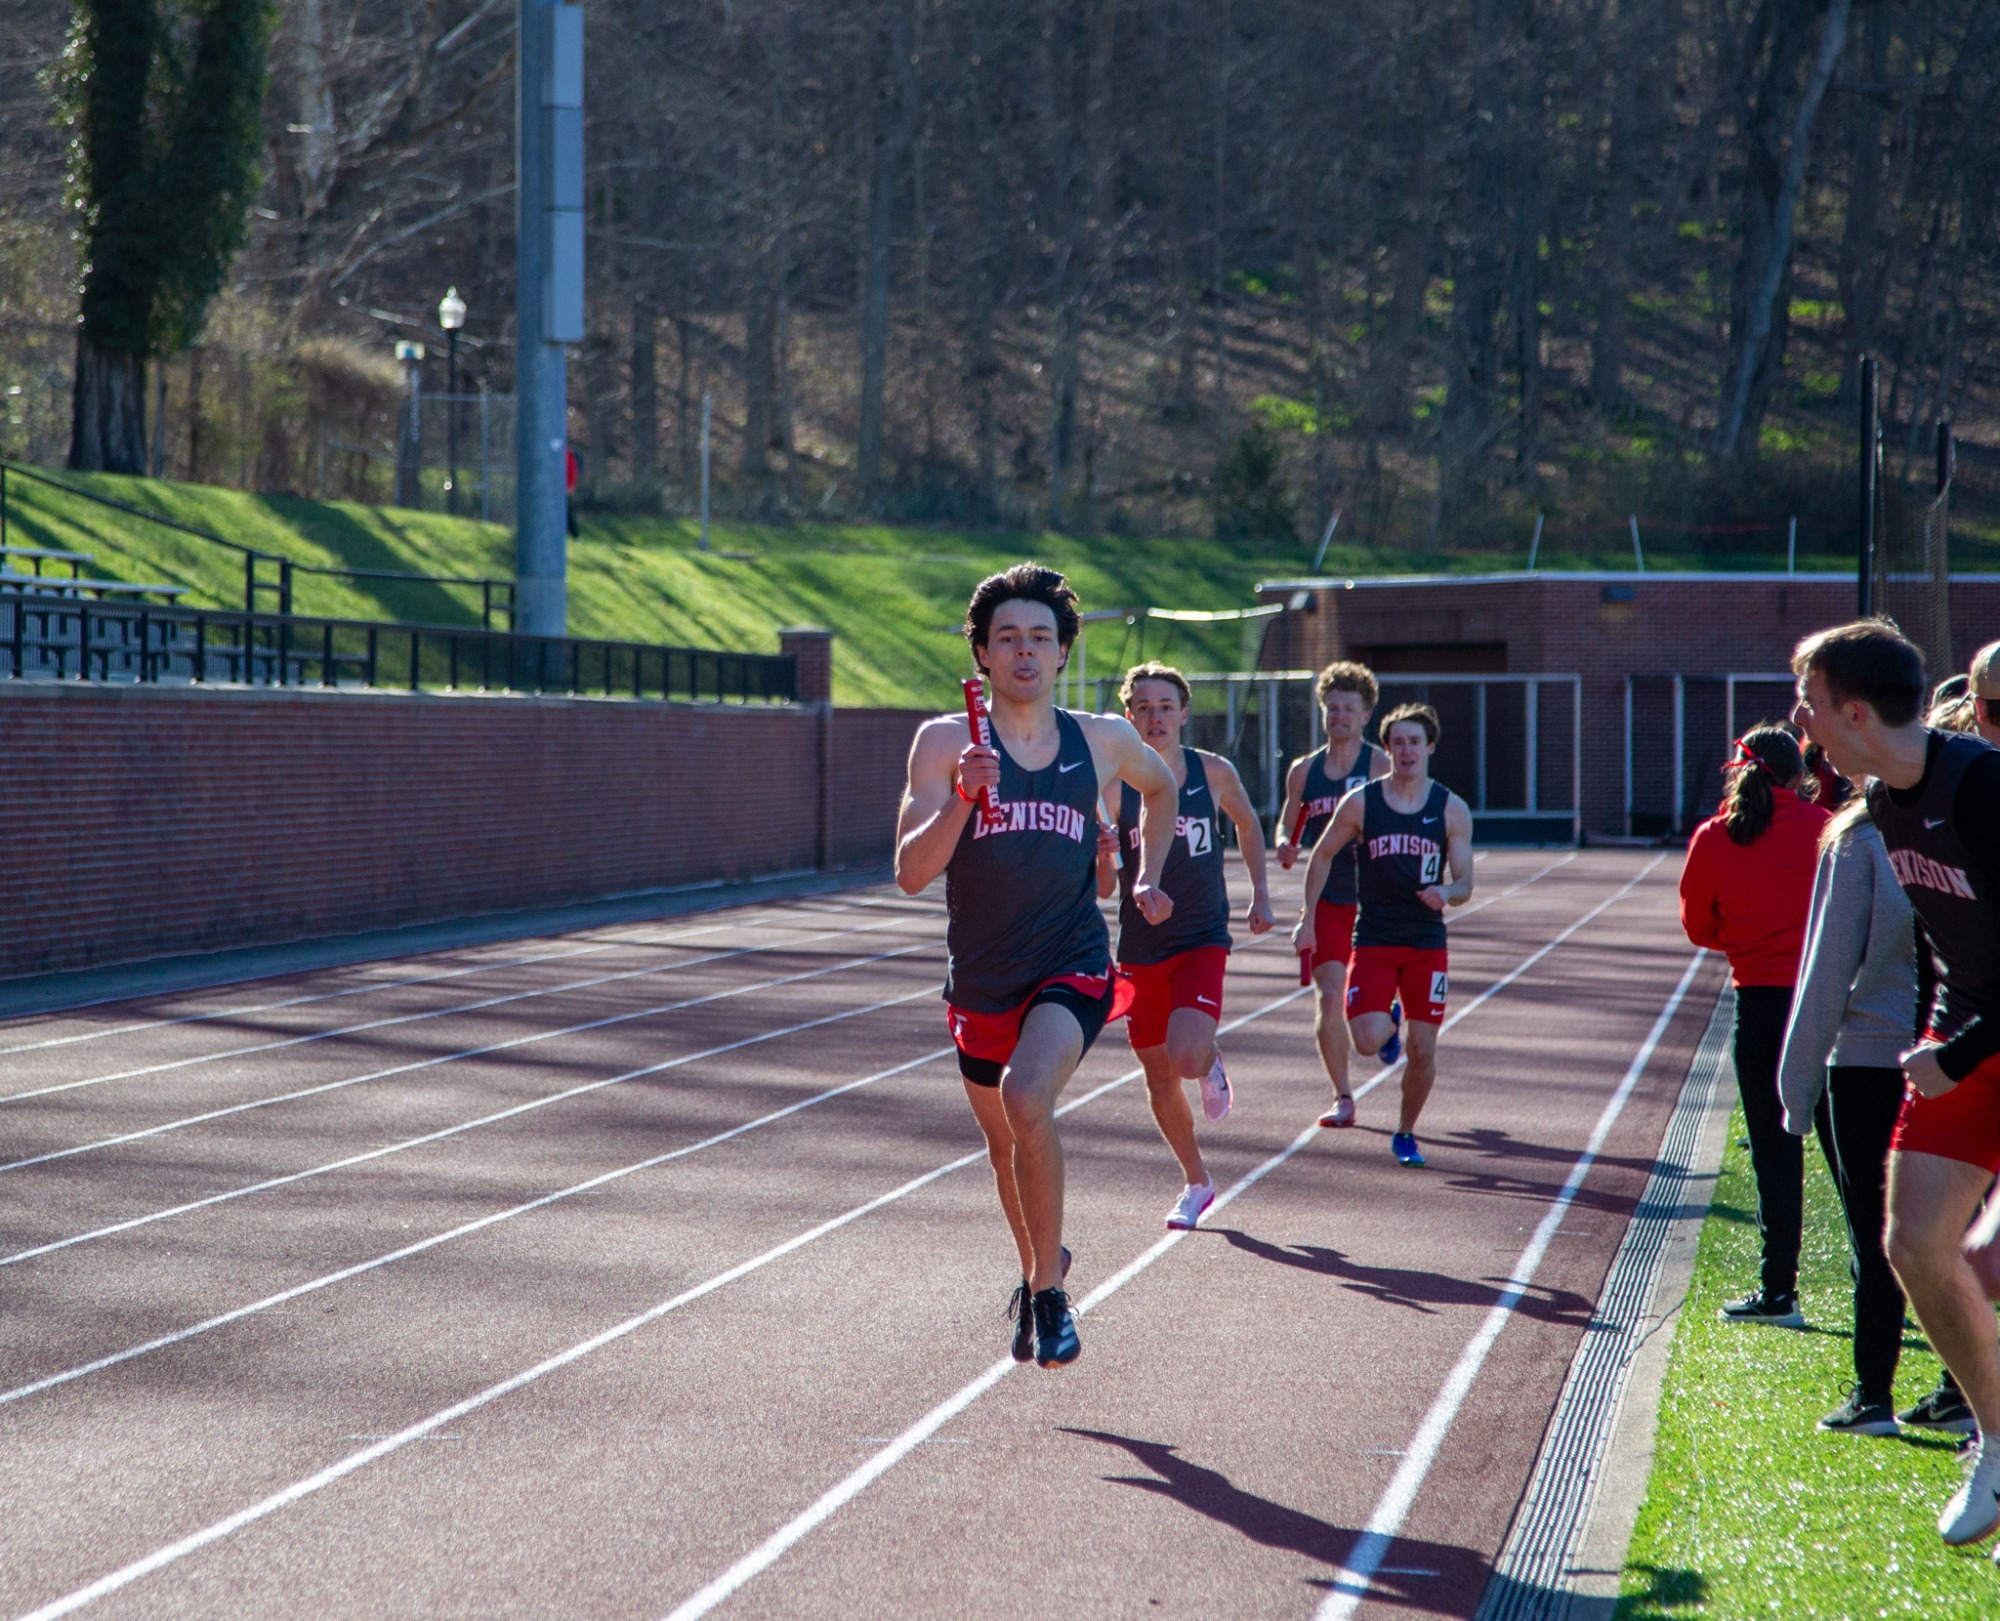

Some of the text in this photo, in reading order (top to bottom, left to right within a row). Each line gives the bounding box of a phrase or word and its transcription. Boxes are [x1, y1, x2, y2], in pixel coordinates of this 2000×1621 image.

[1191, 822, 1208, 854] 2
[1425, 855, 1437, 881] 4
[1888, 849, 1978, 900] ENISON
[1433, 974, 1446, 1002] 4
